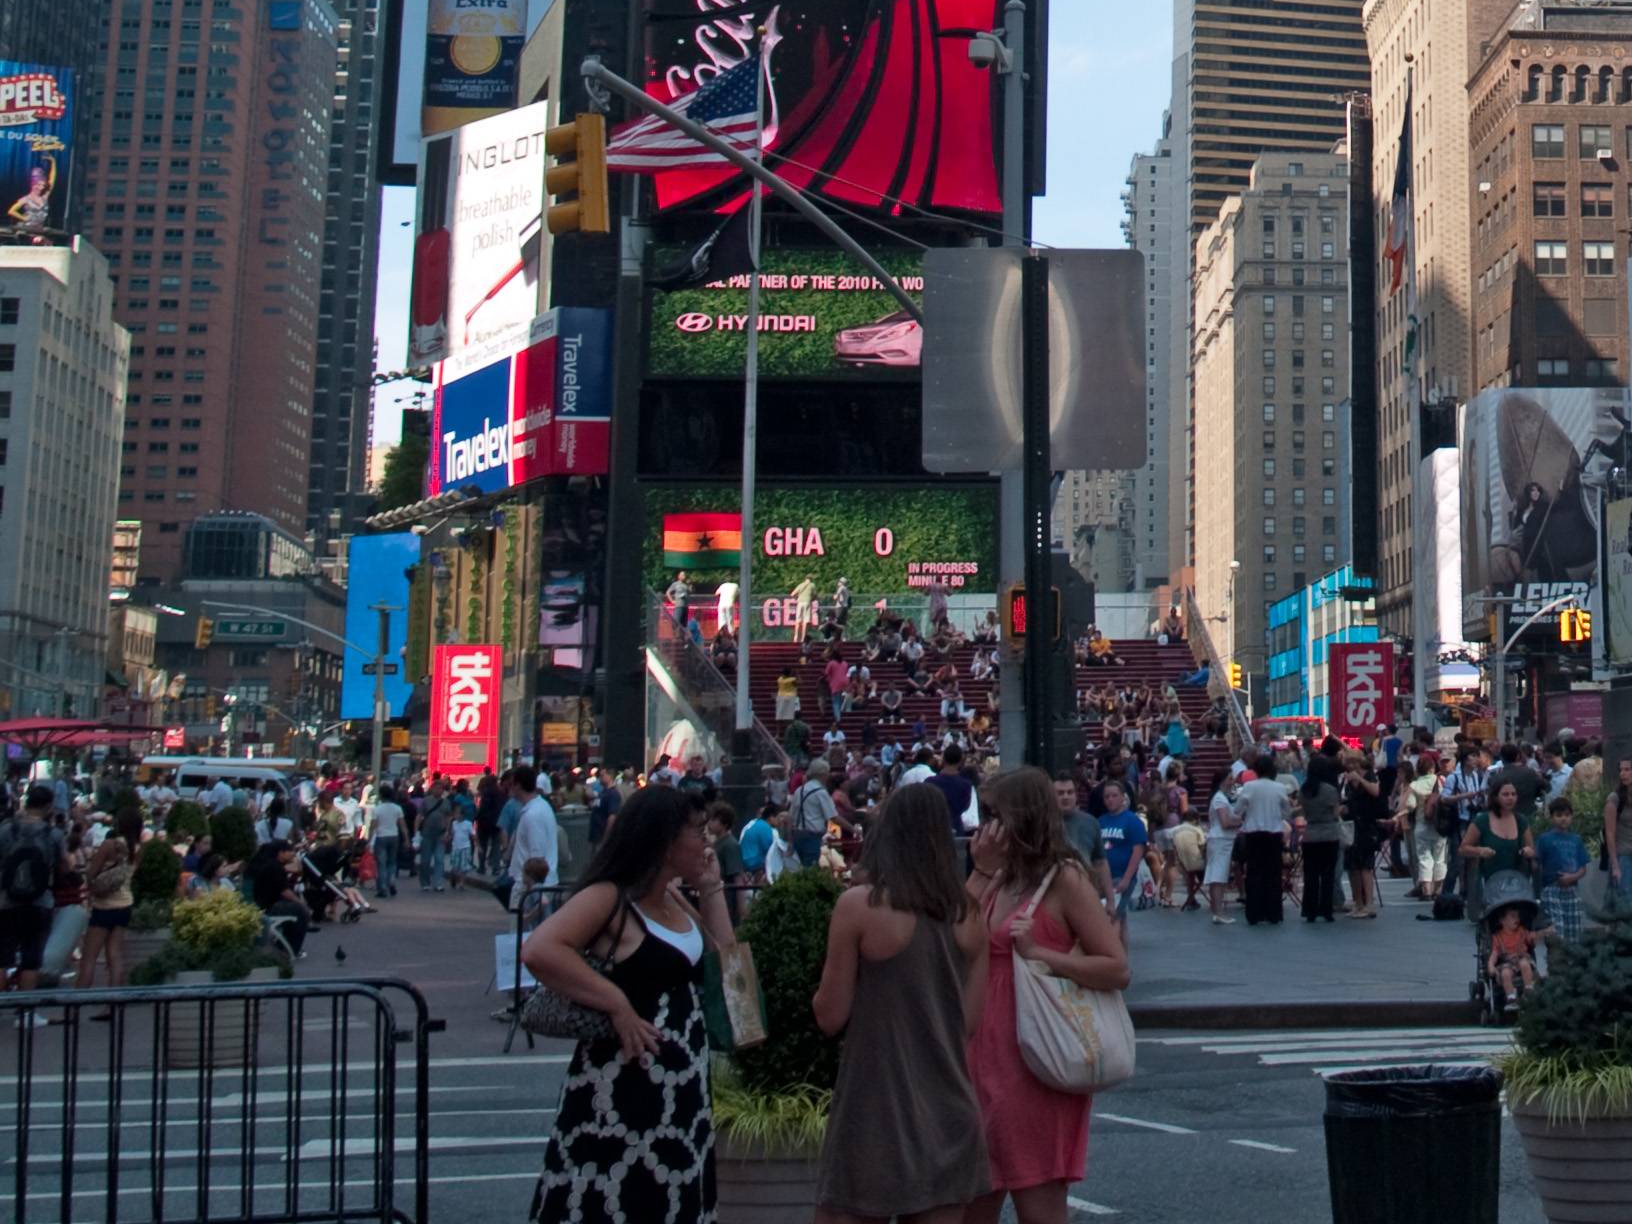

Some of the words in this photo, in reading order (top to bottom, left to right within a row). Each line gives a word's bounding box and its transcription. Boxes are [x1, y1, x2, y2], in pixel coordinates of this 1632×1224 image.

[472, 223, 514, 260] polish
[791, 275, 808, 290] OF
[811, 275, 835, 290] THE
[837, 276, 871, 290] 2010
[562, 334, 583, 413] Travelex
[444, 417, 510, 484] Travelex
[764, 527, 825, 556] GHA
[874, 527, 893, 556] 0
[908, 562, 920, 574] IN
[922, 562, 978, 574] PROGRESS
[908, 575, 949, 587] MINUE
[951, 575, 965, 587] 80
[1511, 582, 1591, 613] LEVER
[230, 624, 239, 633] W
[242, 624, 258, 633] 47
[447, 651, 492, 733] tkts
[1346, 649, 1384, 727] tkts
